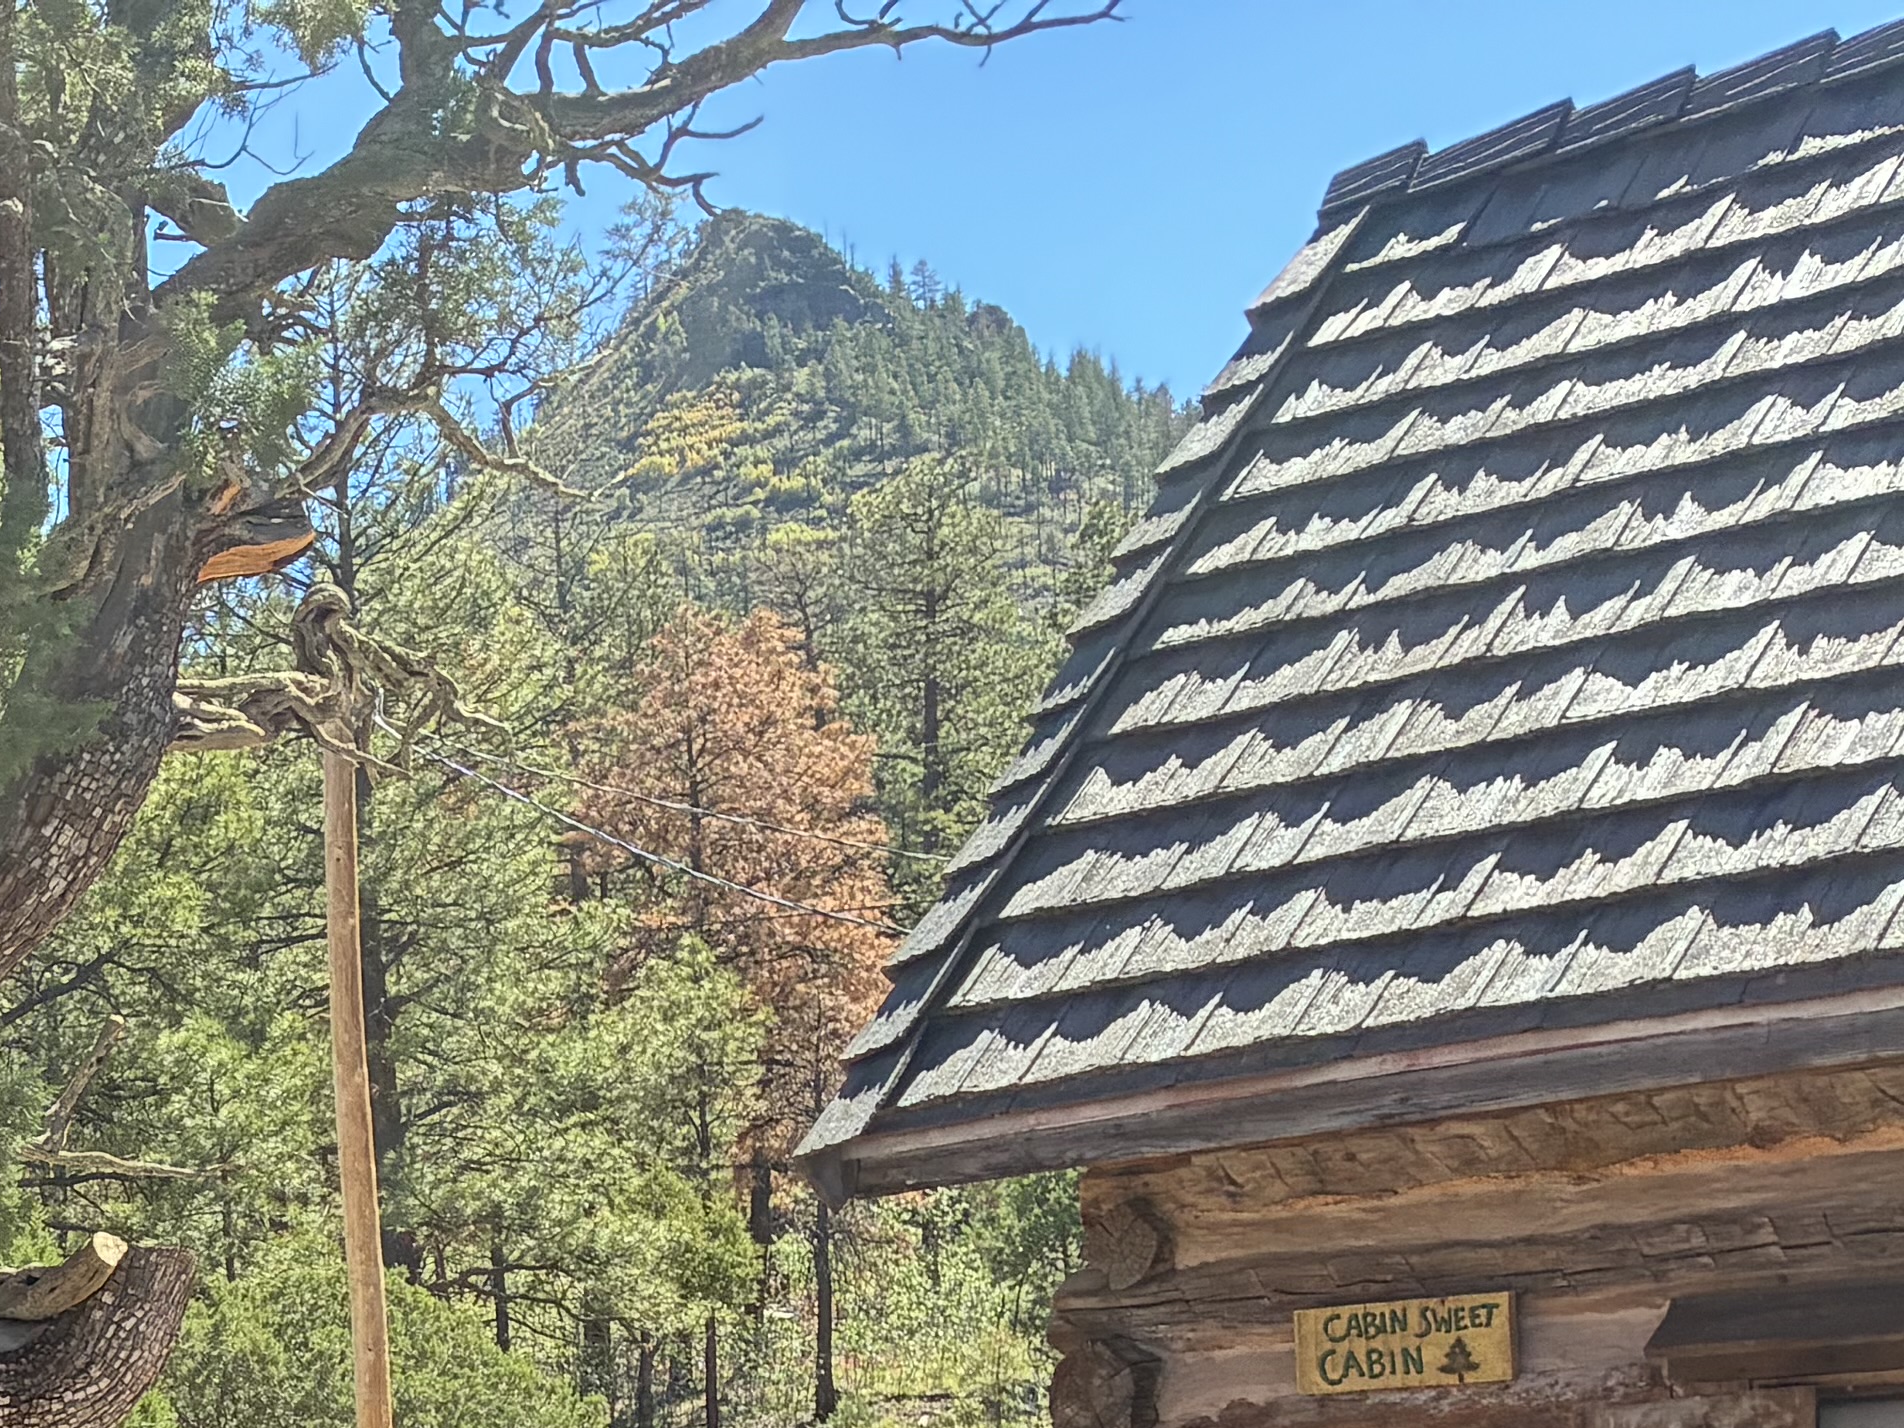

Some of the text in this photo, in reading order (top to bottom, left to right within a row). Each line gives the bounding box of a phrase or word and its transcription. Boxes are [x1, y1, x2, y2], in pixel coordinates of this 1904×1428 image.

[1323, 1303, 1500, 1343] CABIN SWEET
[1318, 1345, 1424, 1386] CABIN
